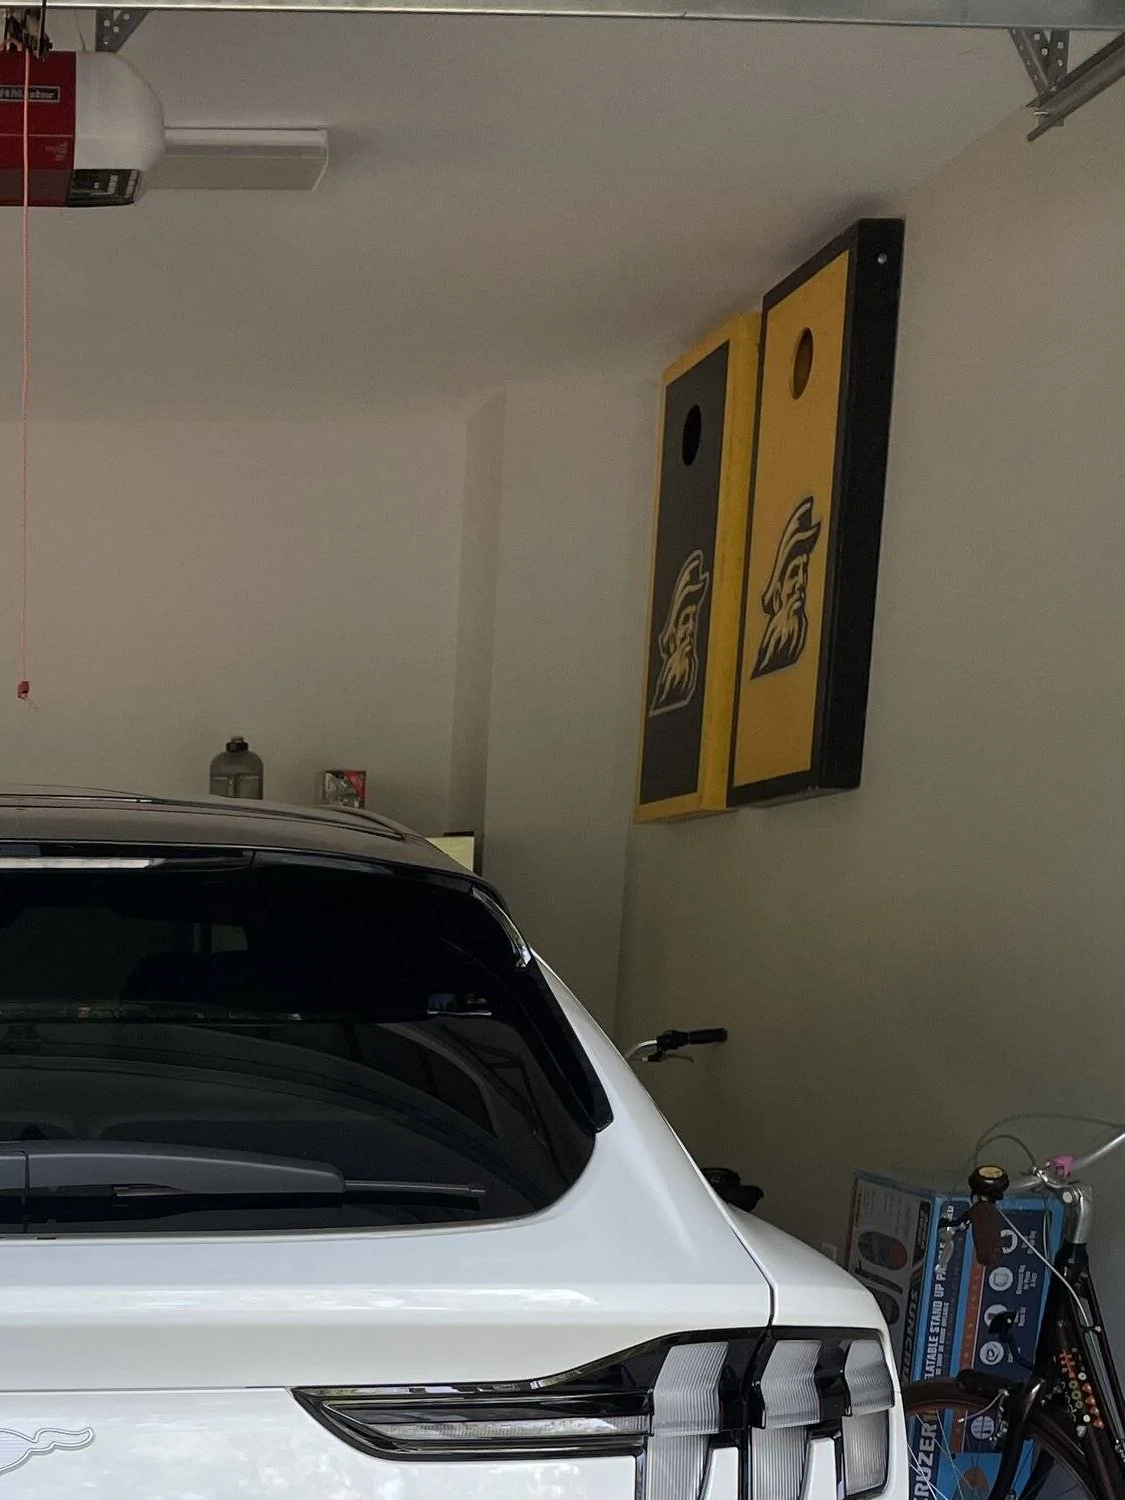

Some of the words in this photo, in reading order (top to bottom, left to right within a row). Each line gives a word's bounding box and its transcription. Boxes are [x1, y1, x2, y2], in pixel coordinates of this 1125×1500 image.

[934, 1283, 945, 1298] UP
[930, 1300, 943, 1331] STAND
[925, 1336, 939, 1381] LATABLE
